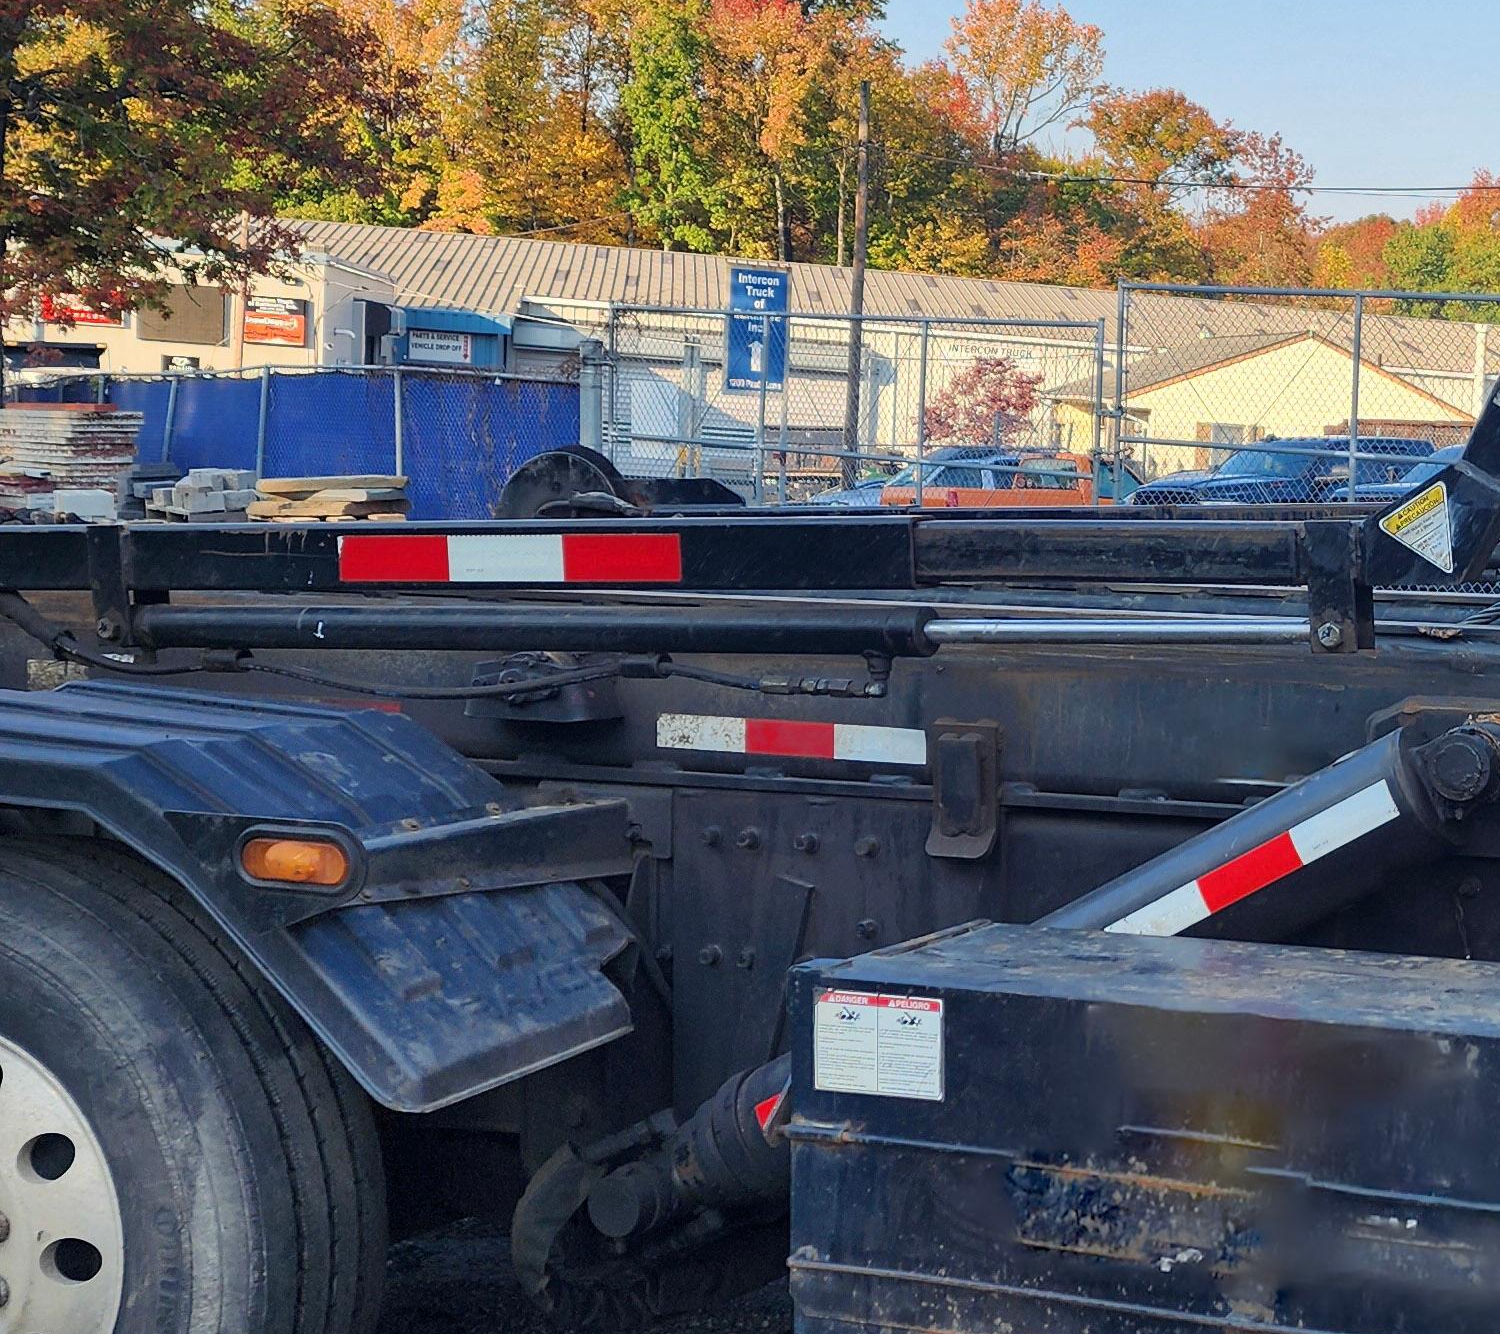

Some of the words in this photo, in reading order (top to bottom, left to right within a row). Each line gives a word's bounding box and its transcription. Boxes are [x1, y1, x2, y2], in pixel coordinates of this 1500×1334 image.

[738, 272, 780, 286] Intercon
[745, 285, 775, 298] Truck
[753, 298, 766, 309] of
[412, 332, 430, 340] PARTS
[436, 333, 460, 341] SERVICE
[948, 344, 999, 356] INTERCON
[1000, 347, 1033, 359] TRUCK
[1402, 495, 1430, 516] CAUTION
[835, 993, 869, 1005] DANGER
[895, 999, 931, 1011] PELIGRO
